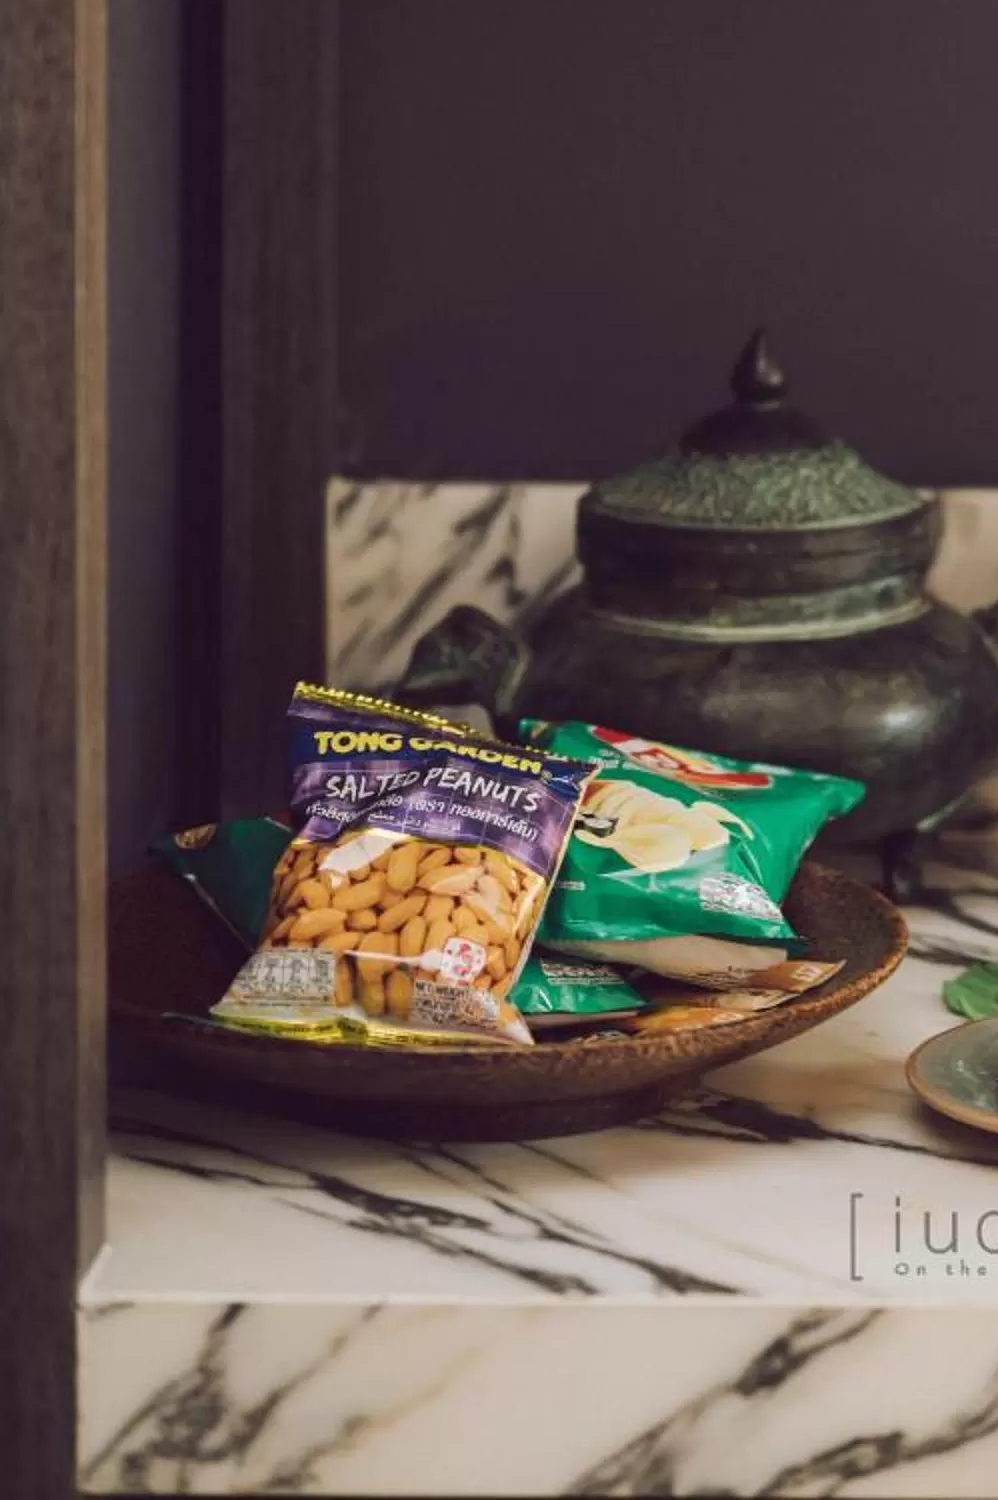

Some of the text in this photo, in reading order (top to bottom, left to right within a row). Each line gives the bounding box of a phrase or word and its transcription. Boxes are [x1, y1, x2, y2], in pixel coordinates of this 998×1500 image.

[314, 731, 404, 754] TONG
[326, 766, 541, 813] SALTED PEANUTS
